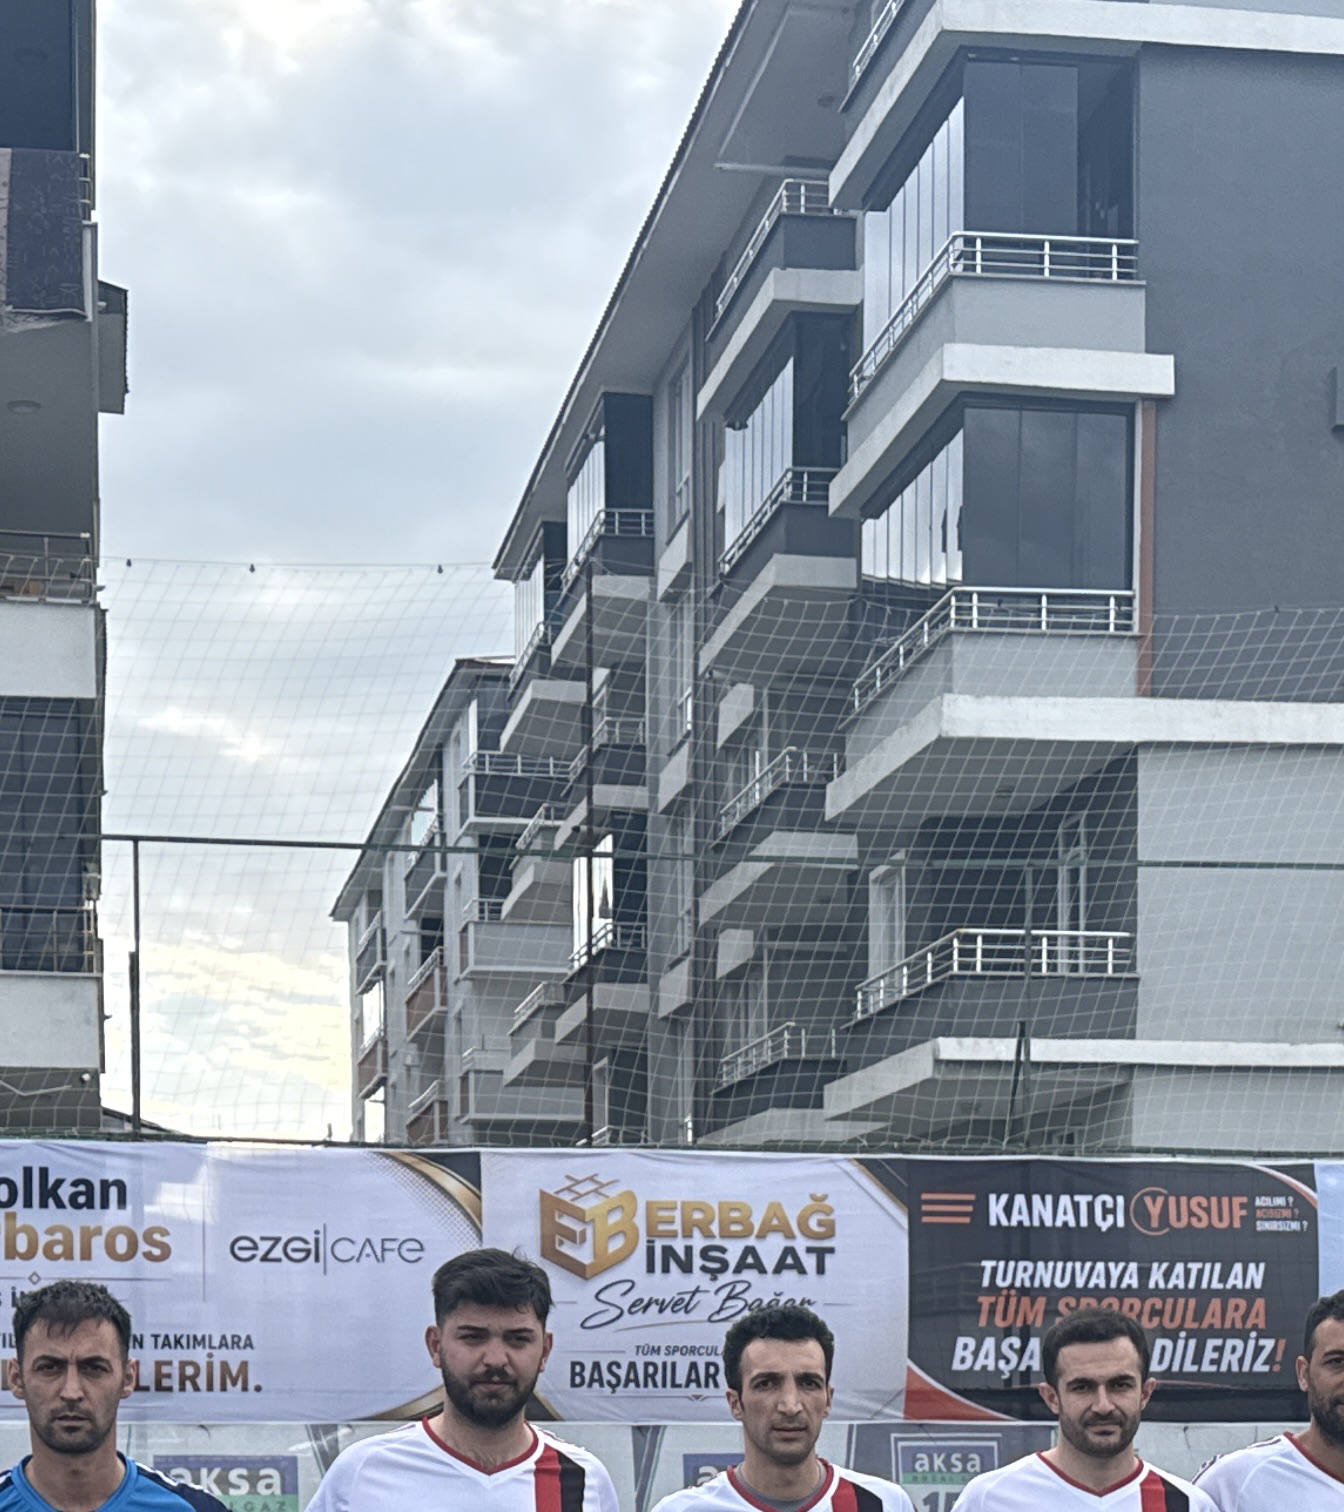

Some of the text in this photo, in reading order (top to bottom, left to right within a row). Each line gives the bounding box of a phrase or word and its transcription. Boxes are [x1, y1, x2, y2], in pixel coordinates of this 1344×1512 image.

[644, 1193, 837, 1241] ERBAĞ
[987, 1193, 1248, 1233] KANATÇI YUSUF
[644, 1238, 837, 1281] İNŞAAT
[979, 1259, 1266, 1290] TURNUVAYA KATILAN
[579, 1279, 710, 1330] Servet
[976, 1289, 1046, 1329] TÜM
[150, 1333, 255, 1351] TAKIMLARA
[634, 1343, 724, 1358] TÜM SPORCUL
[1149, 1330, 1287, 1373] DİLERİZ!
[134, 1351, 264, 1393] LERİM.
[569, 1359, 720, 1396] BAŞARILAR
[170, 1466, 283, 1497] aksa
[914, 1452, 981, 1473] aksa
